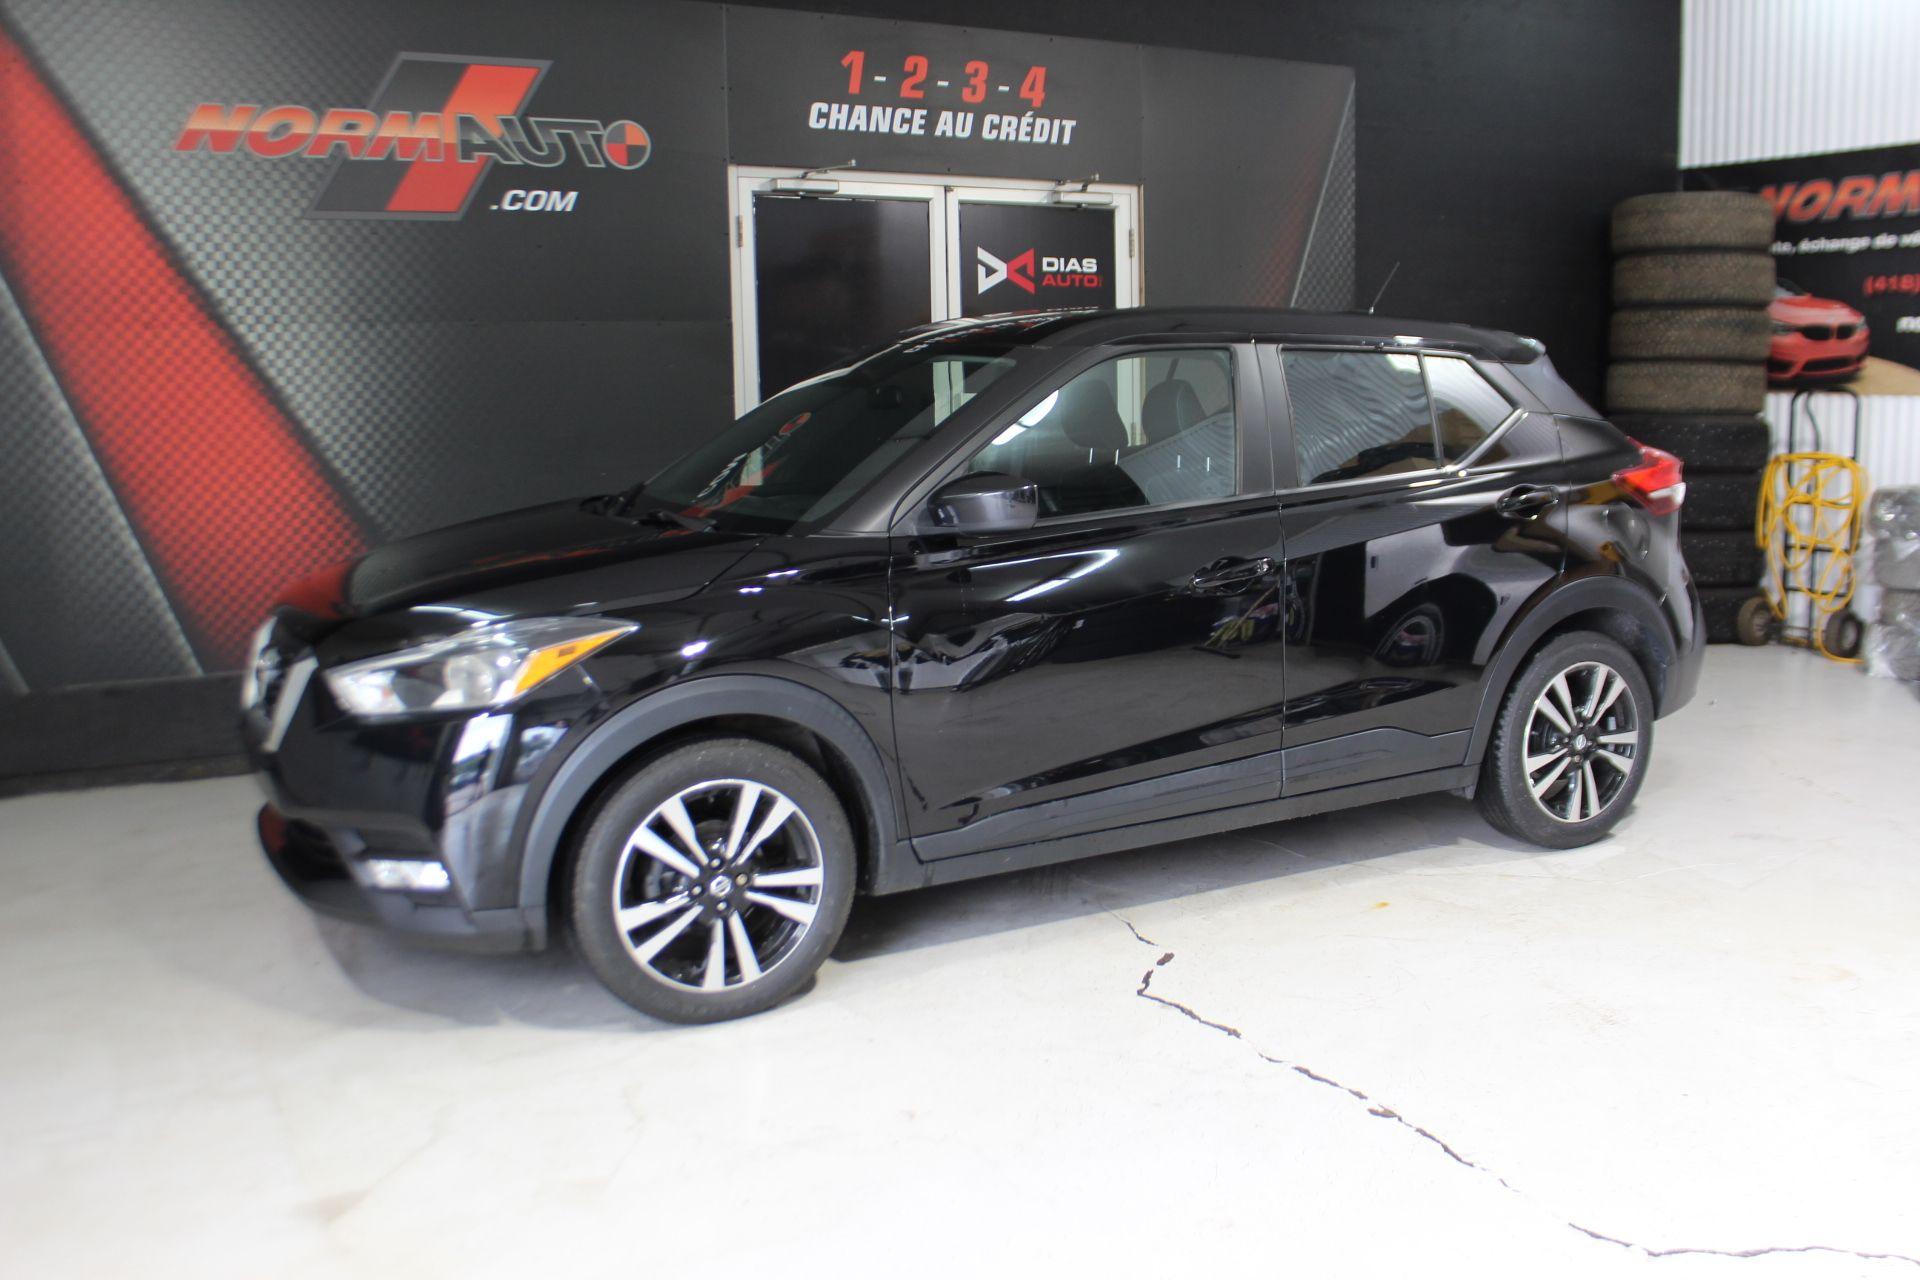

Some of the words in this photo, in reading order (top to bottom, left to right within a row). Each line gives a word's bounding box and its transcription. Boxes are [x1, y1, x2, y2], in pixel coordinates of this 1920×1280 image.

[808, 102, 927, 136] CHANCE
[934, 110, 974, 139] AU
[982, 111, 1077, 146] CRÉDIT
[490, 188, 578, 213] .COM
[1872, 232, 1899, 250] de
[1042, 256, 1098, 273] DIAS
[1042, 273, 1099, 288] AUTO
